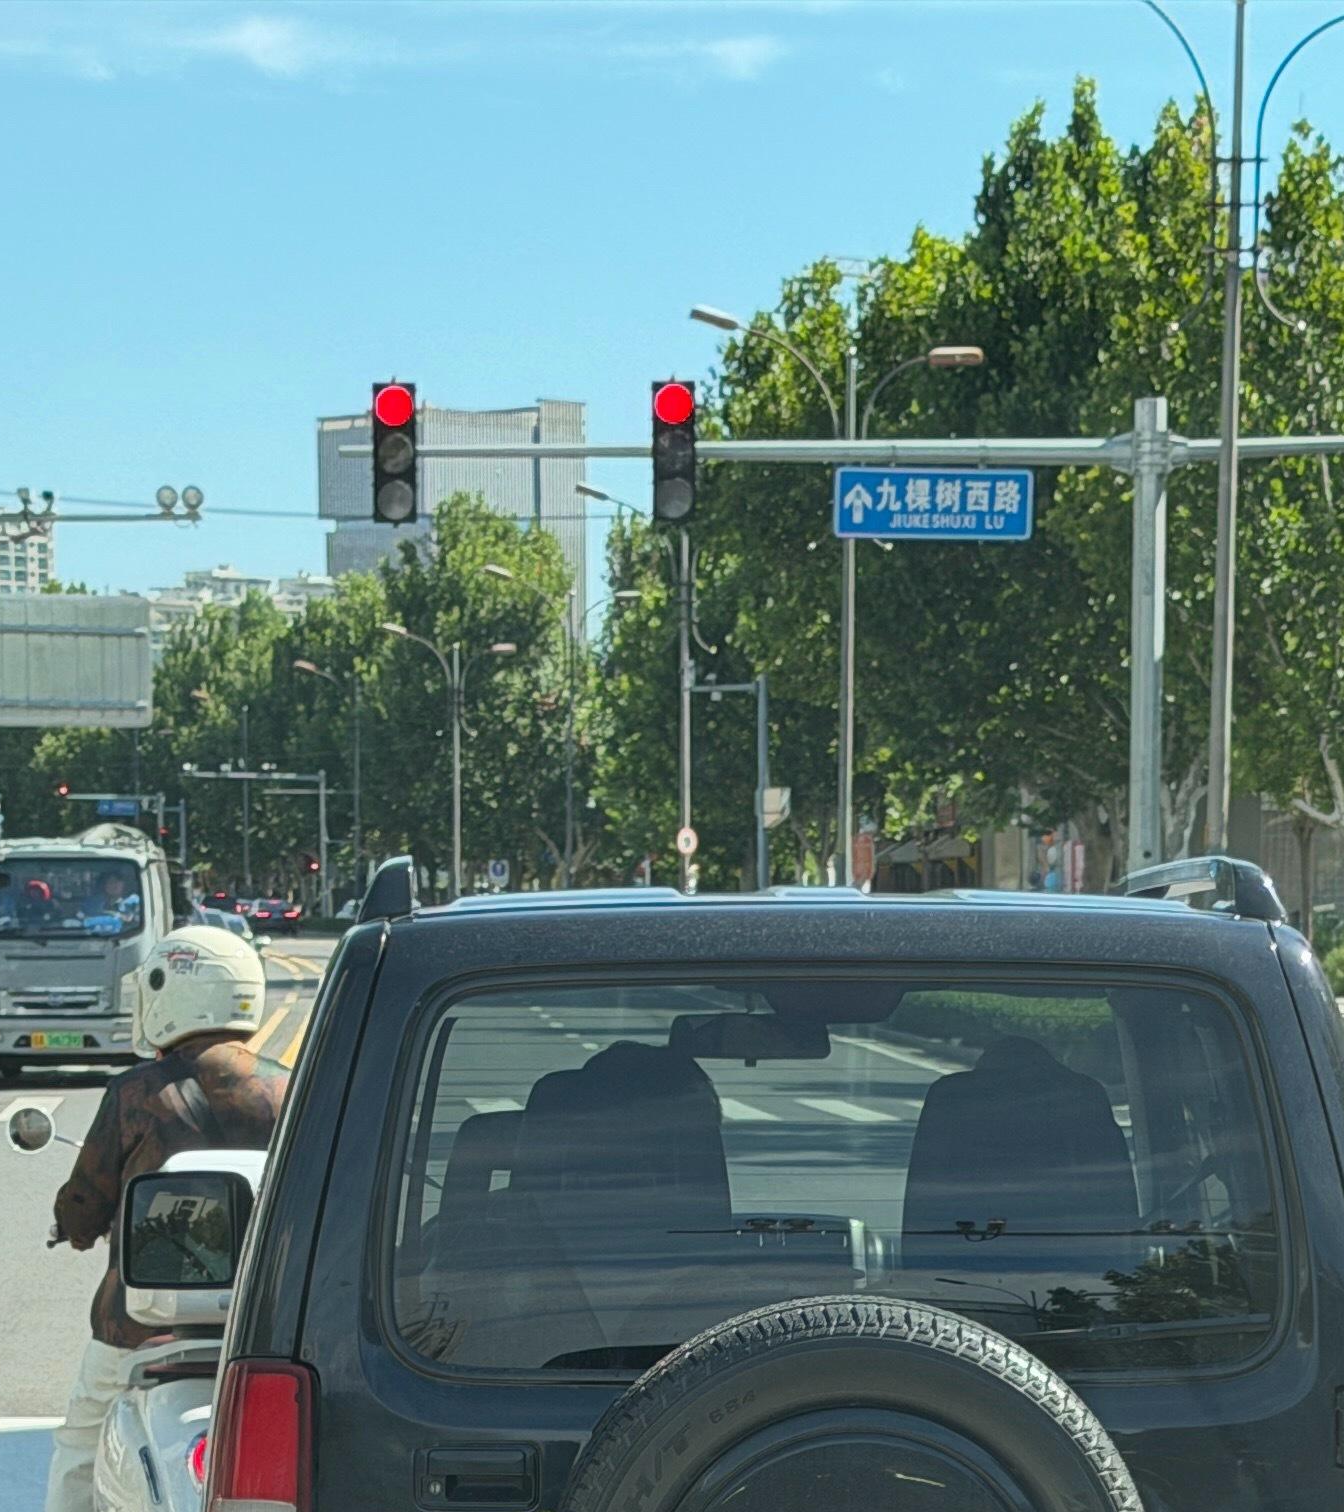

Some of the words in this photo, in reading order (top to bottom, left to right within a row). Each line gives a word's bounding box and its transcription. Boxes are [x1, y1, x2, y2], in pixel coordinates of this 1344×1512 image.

[876, 478, 1021, 513] 九棵树西路
[984, 515, 1005, 530] LU
